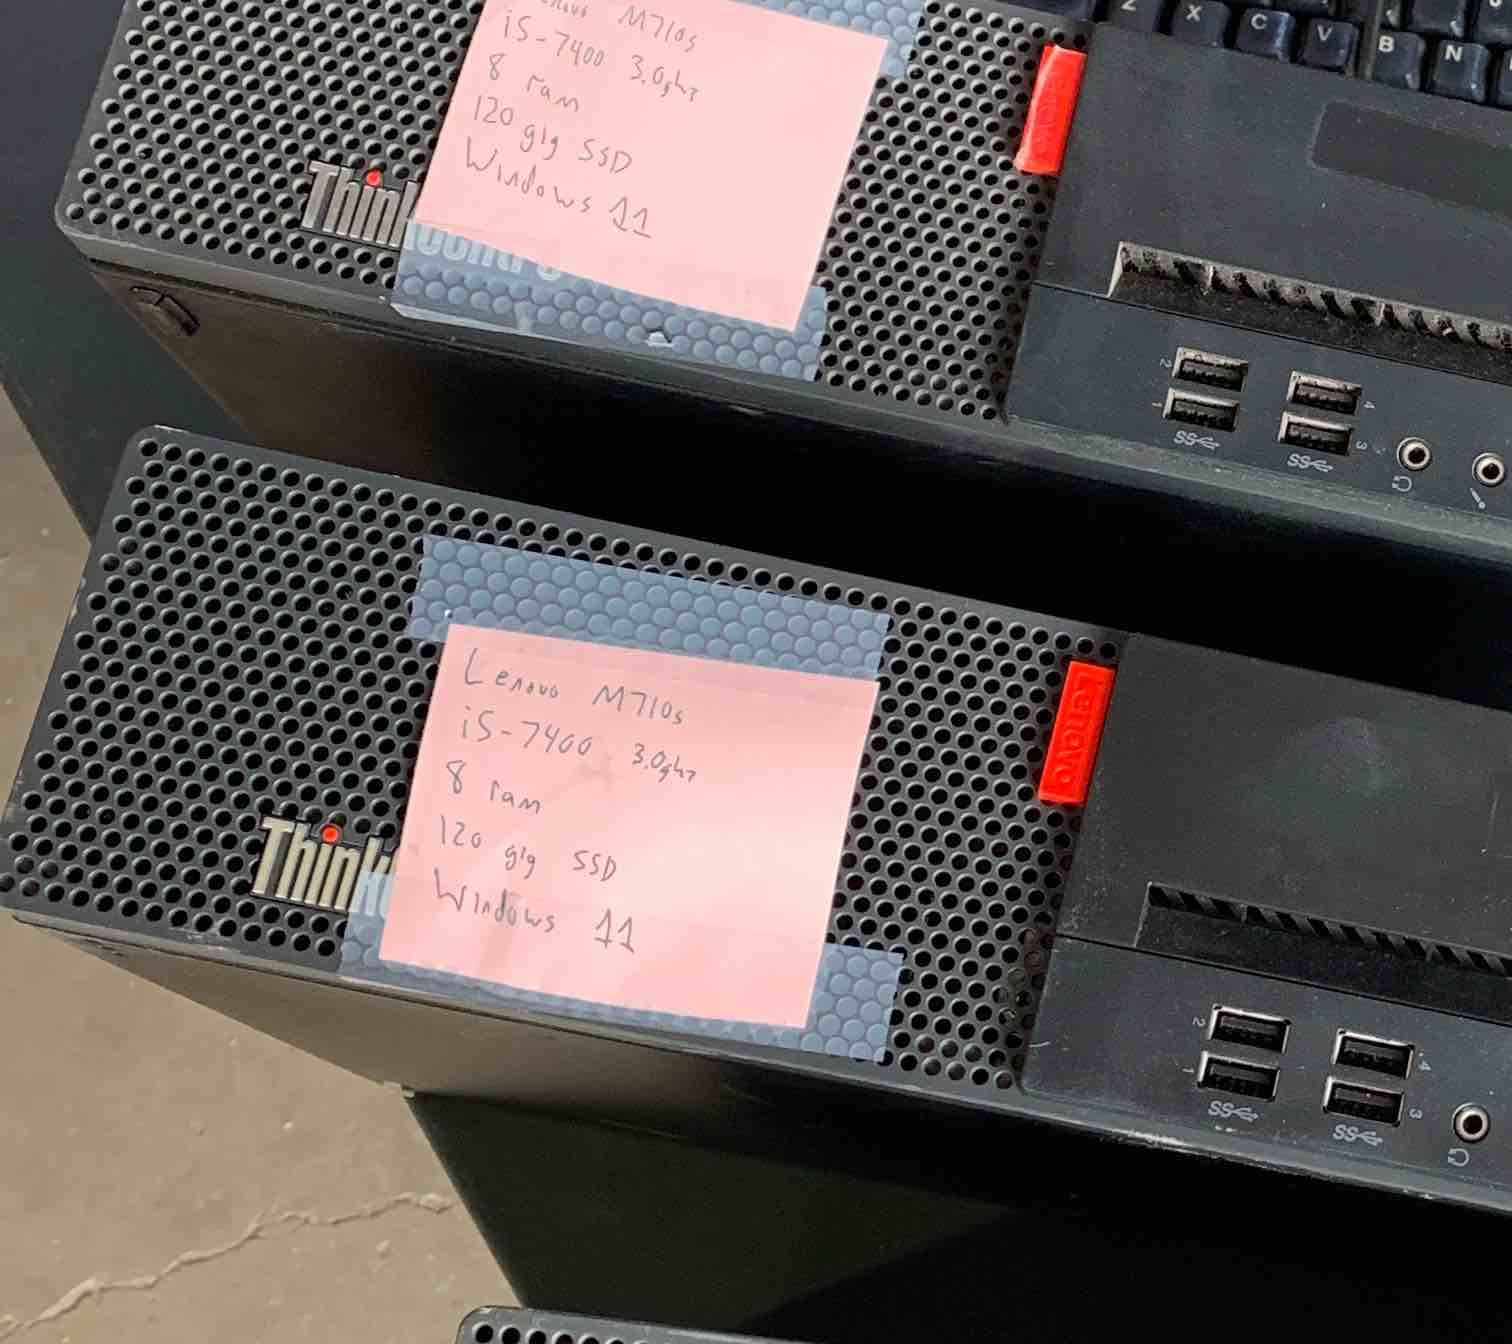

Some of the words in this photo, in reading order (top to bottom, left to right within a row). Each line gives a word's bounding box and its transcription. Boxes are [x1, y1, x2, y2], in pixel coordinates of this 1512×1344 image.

[502, 9, 606, 68] i5-7400
[619, 5, 698, 52] M710s
[1186, 5, 1201, 21] X
[1251, 14, 1267, 31] C
[1317, 24, 1333, 41] V
[1379, 36, 1395, 52] B
[1446, 46, 1462, 62] N
[488, 52, 507, 80] 8
[525, 74, 579, 113] ram
[474, 95, 514, 127] 120
[578, 138, 634, 175] SSD
[466, 136, 591, 213] Windows
[609, 199, 653, 240] 11
[464, 647, 561, 701] Lenovo
[592, 685, 685, 726] M710s
[461, 706, 592, 757] i5-7400
[447, 759, 466, 795] 8
[489, 781, 542, 814] ram
[440, 815, 482, 848] 120
[572, 850, 618, 881] SSD
[434, 868, 555, 932] Windows
[594, 909, 634, 953] 11
